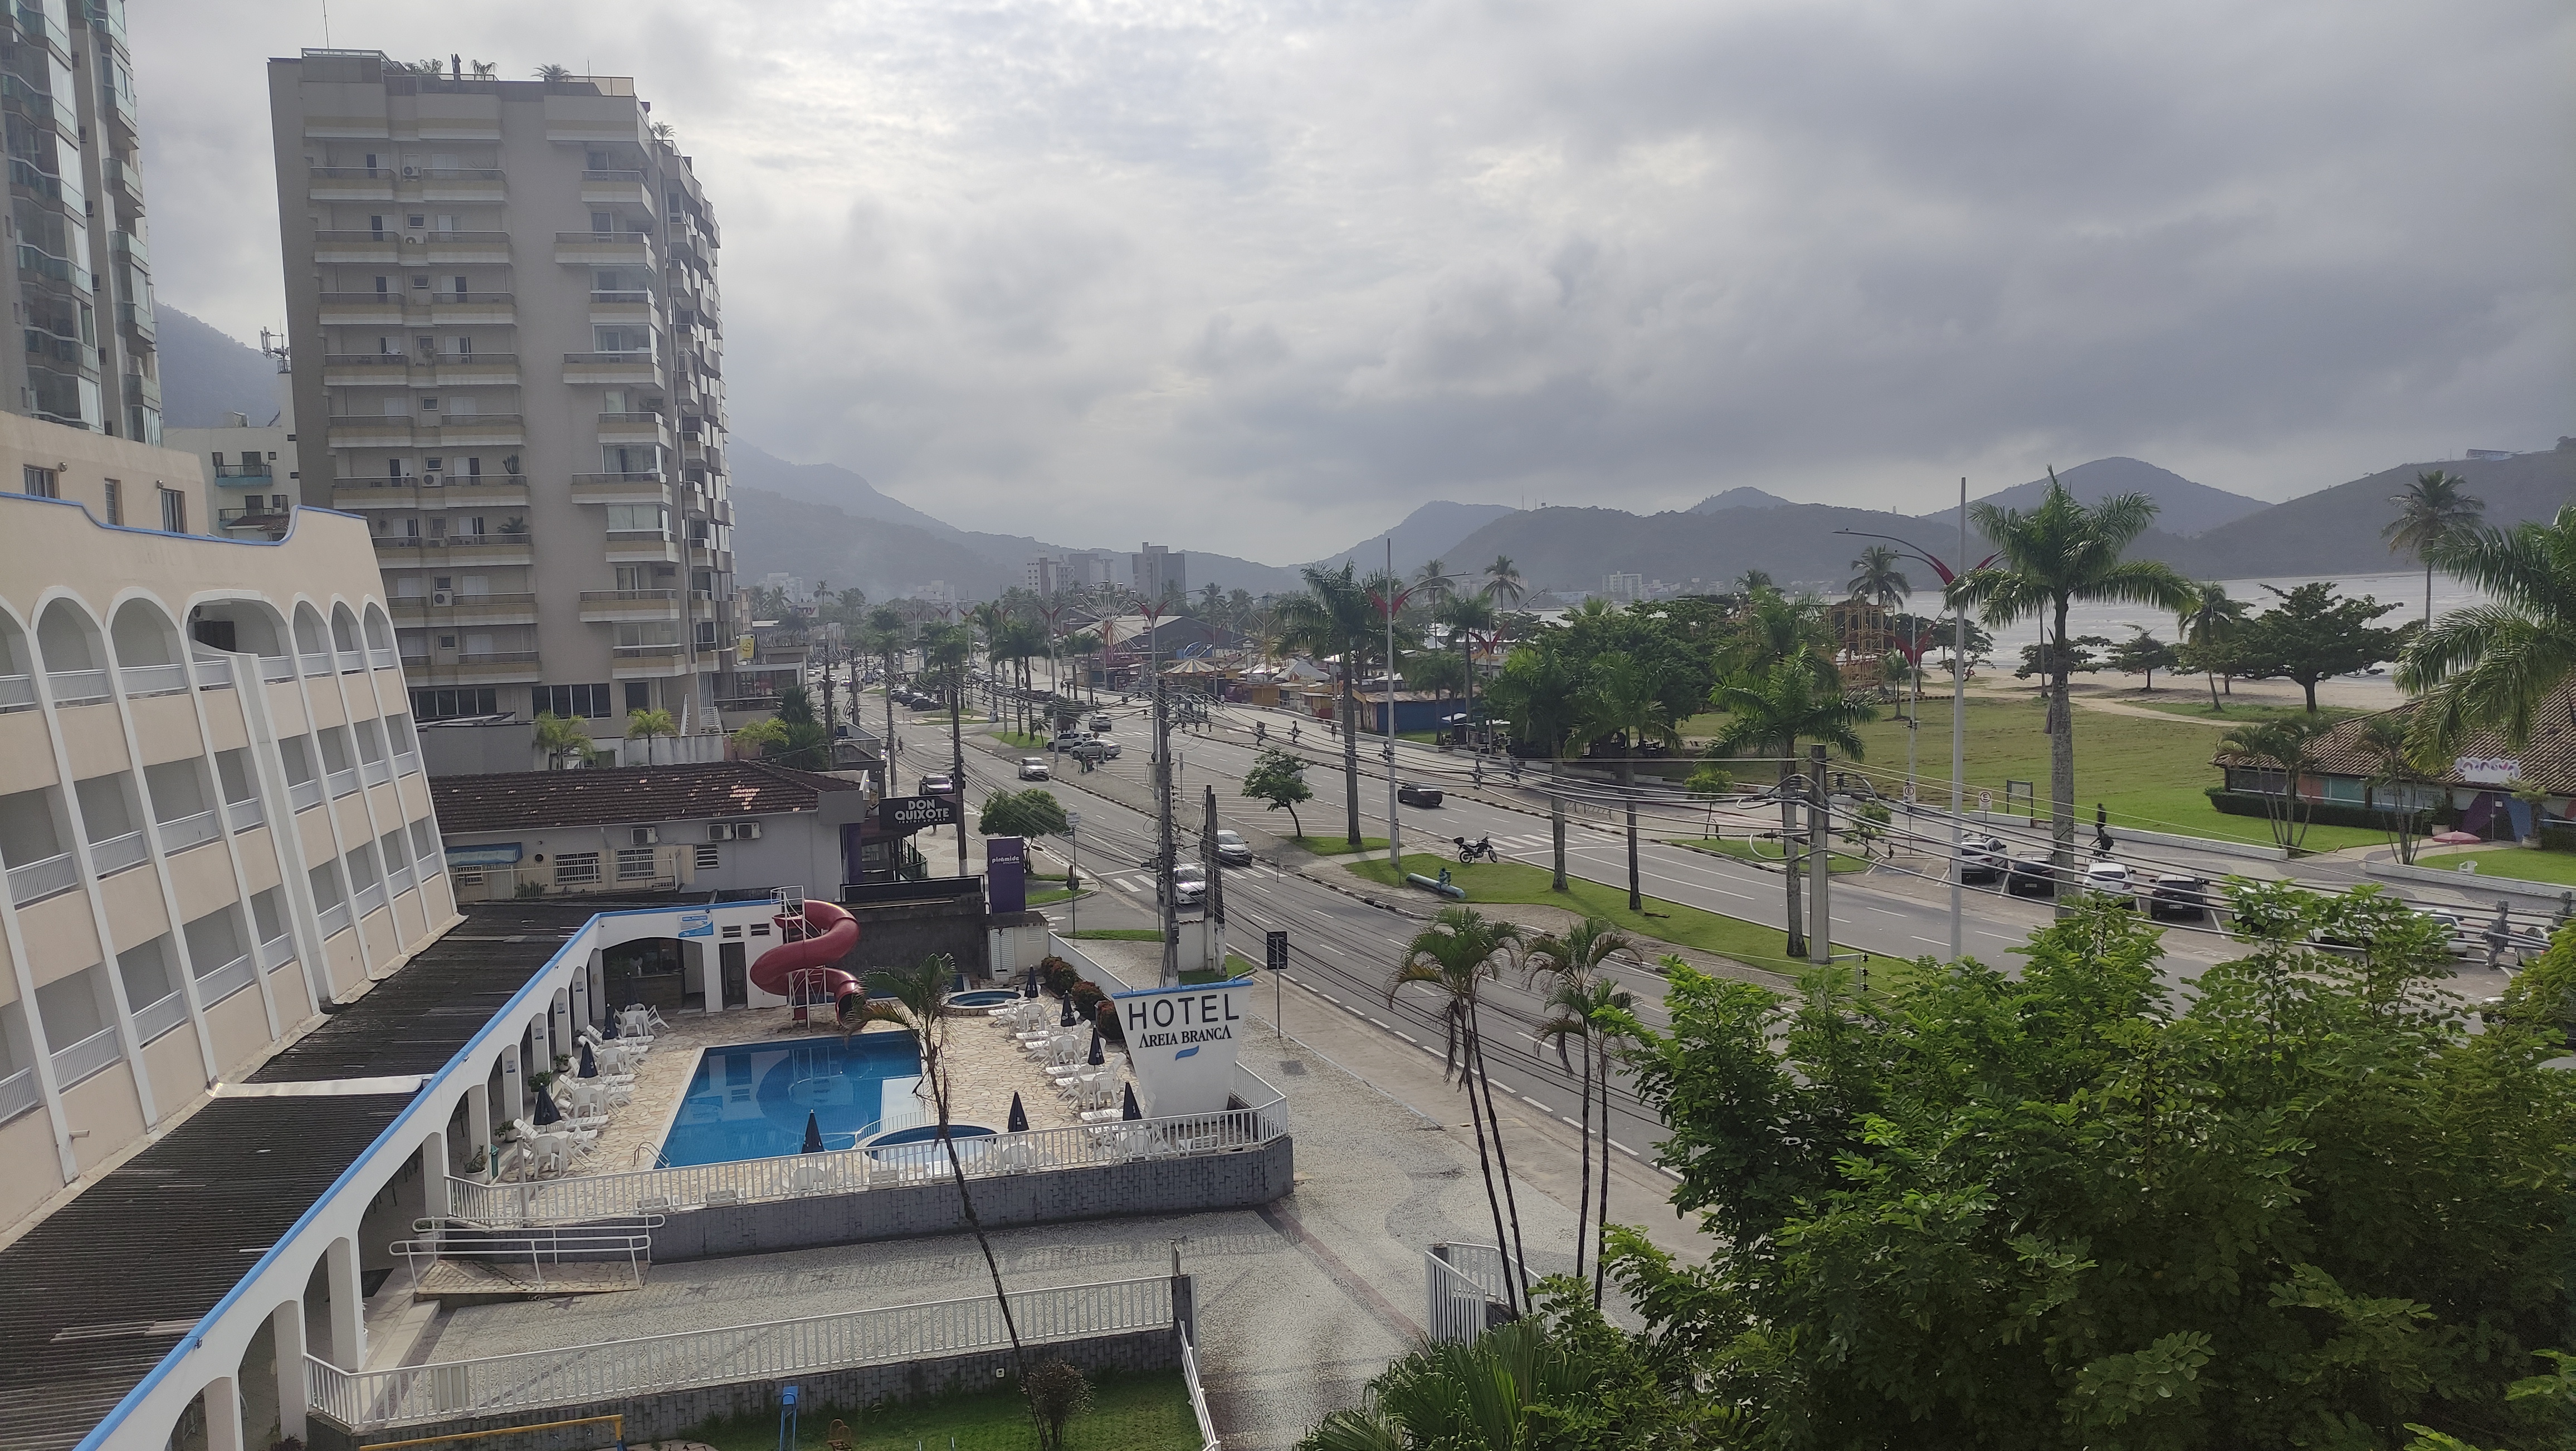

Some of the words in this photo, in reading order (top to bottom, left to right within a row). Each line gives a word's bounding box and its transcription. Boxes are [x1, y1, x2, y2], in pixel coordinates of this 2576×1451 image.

[895, 807, 949, 821] QUIXOTE
[908, 799, 935, 810] DON
[1128, 994, 1240, 1031] HOTEL
[1138, 1033, 1178, 1049] AREIA
[1181, 1024, 1232, 1044] BRANCA
